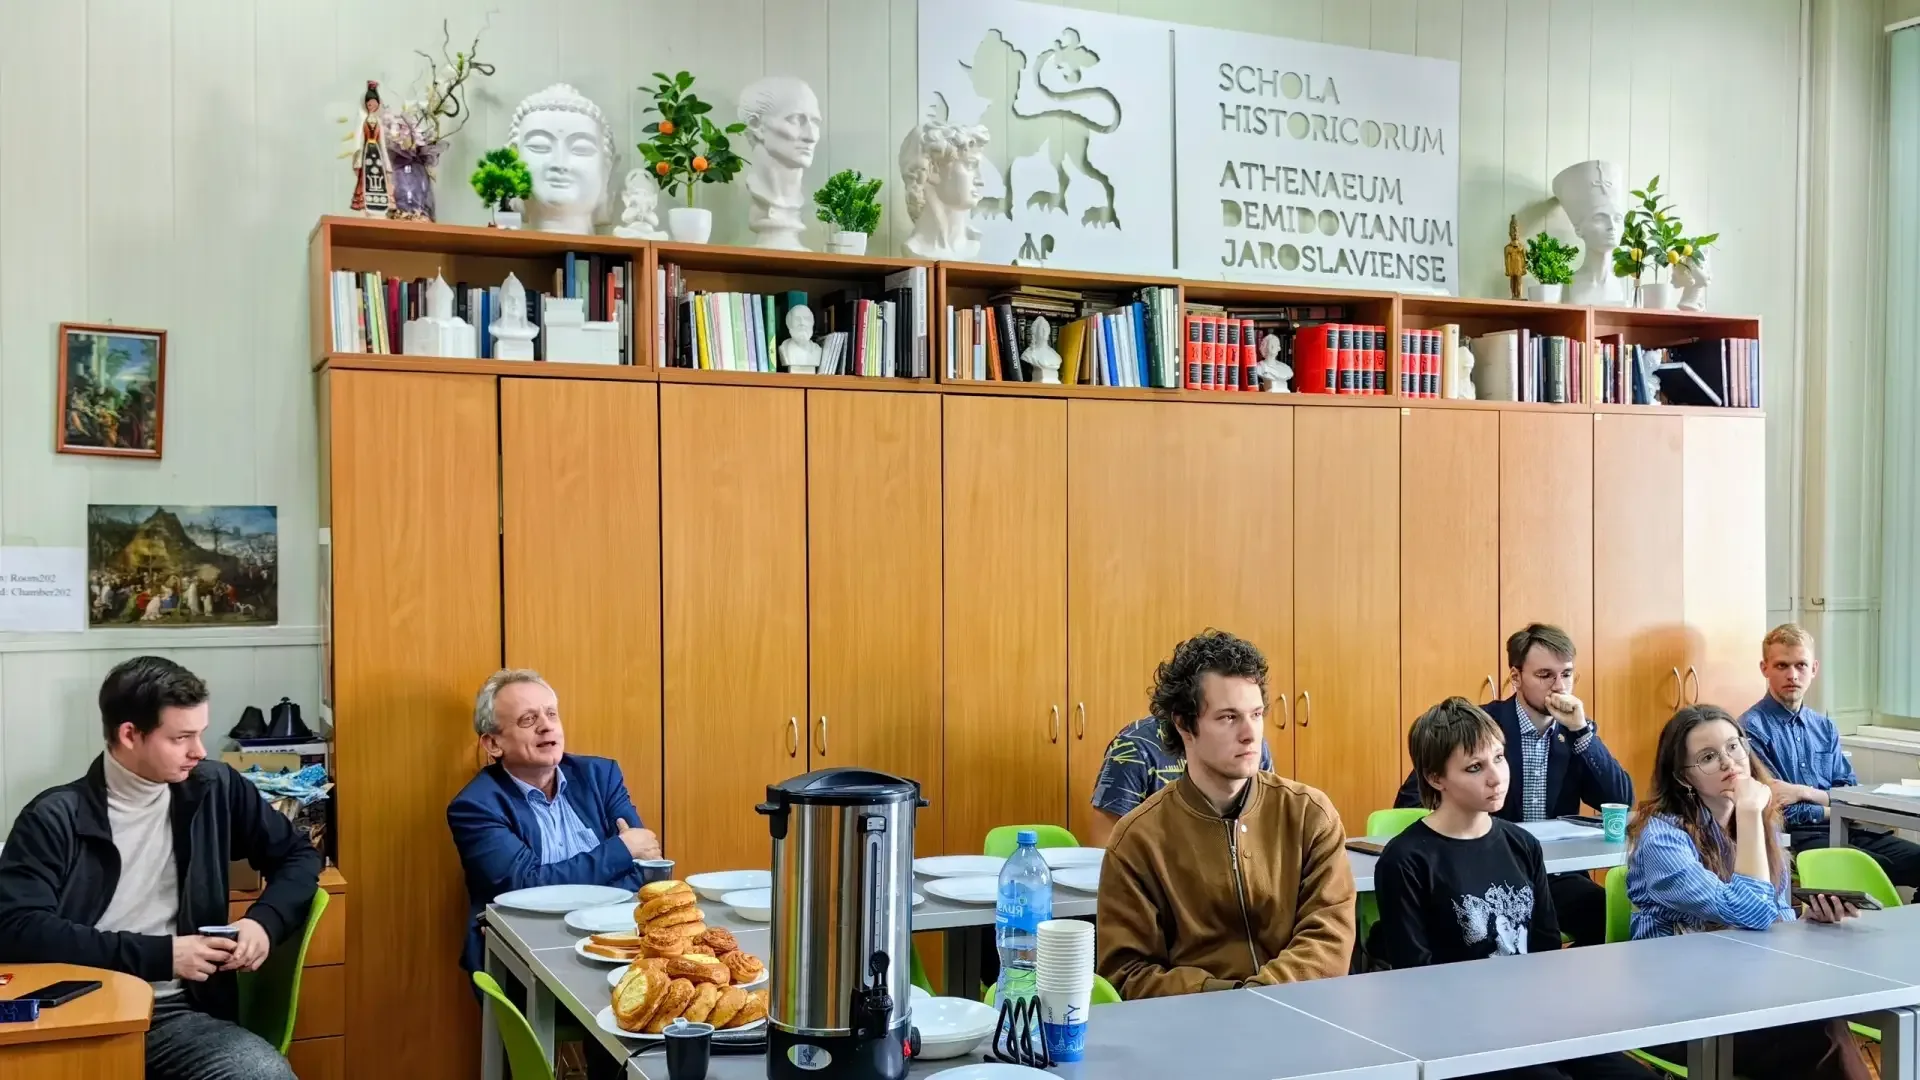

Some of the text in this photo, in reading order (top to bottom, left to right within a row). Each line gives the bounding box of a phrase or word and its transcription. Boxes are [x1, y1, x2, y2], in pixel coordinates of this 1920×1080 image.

[1218, 62, 1340, 104] SCHOLA
[1218, 102, 1445, 156] HISTORICORUM
[1218, 160, 1403, 205] ATHENAEUM
[1220, 199, 1453, 247] DEMIDOVIANUM
[1220, 238, 1446, 282] JAROSLAVIENSE
[11, 588, 71, 597] Chamber202
[1067, 1004, 1081, 1038] CITY
